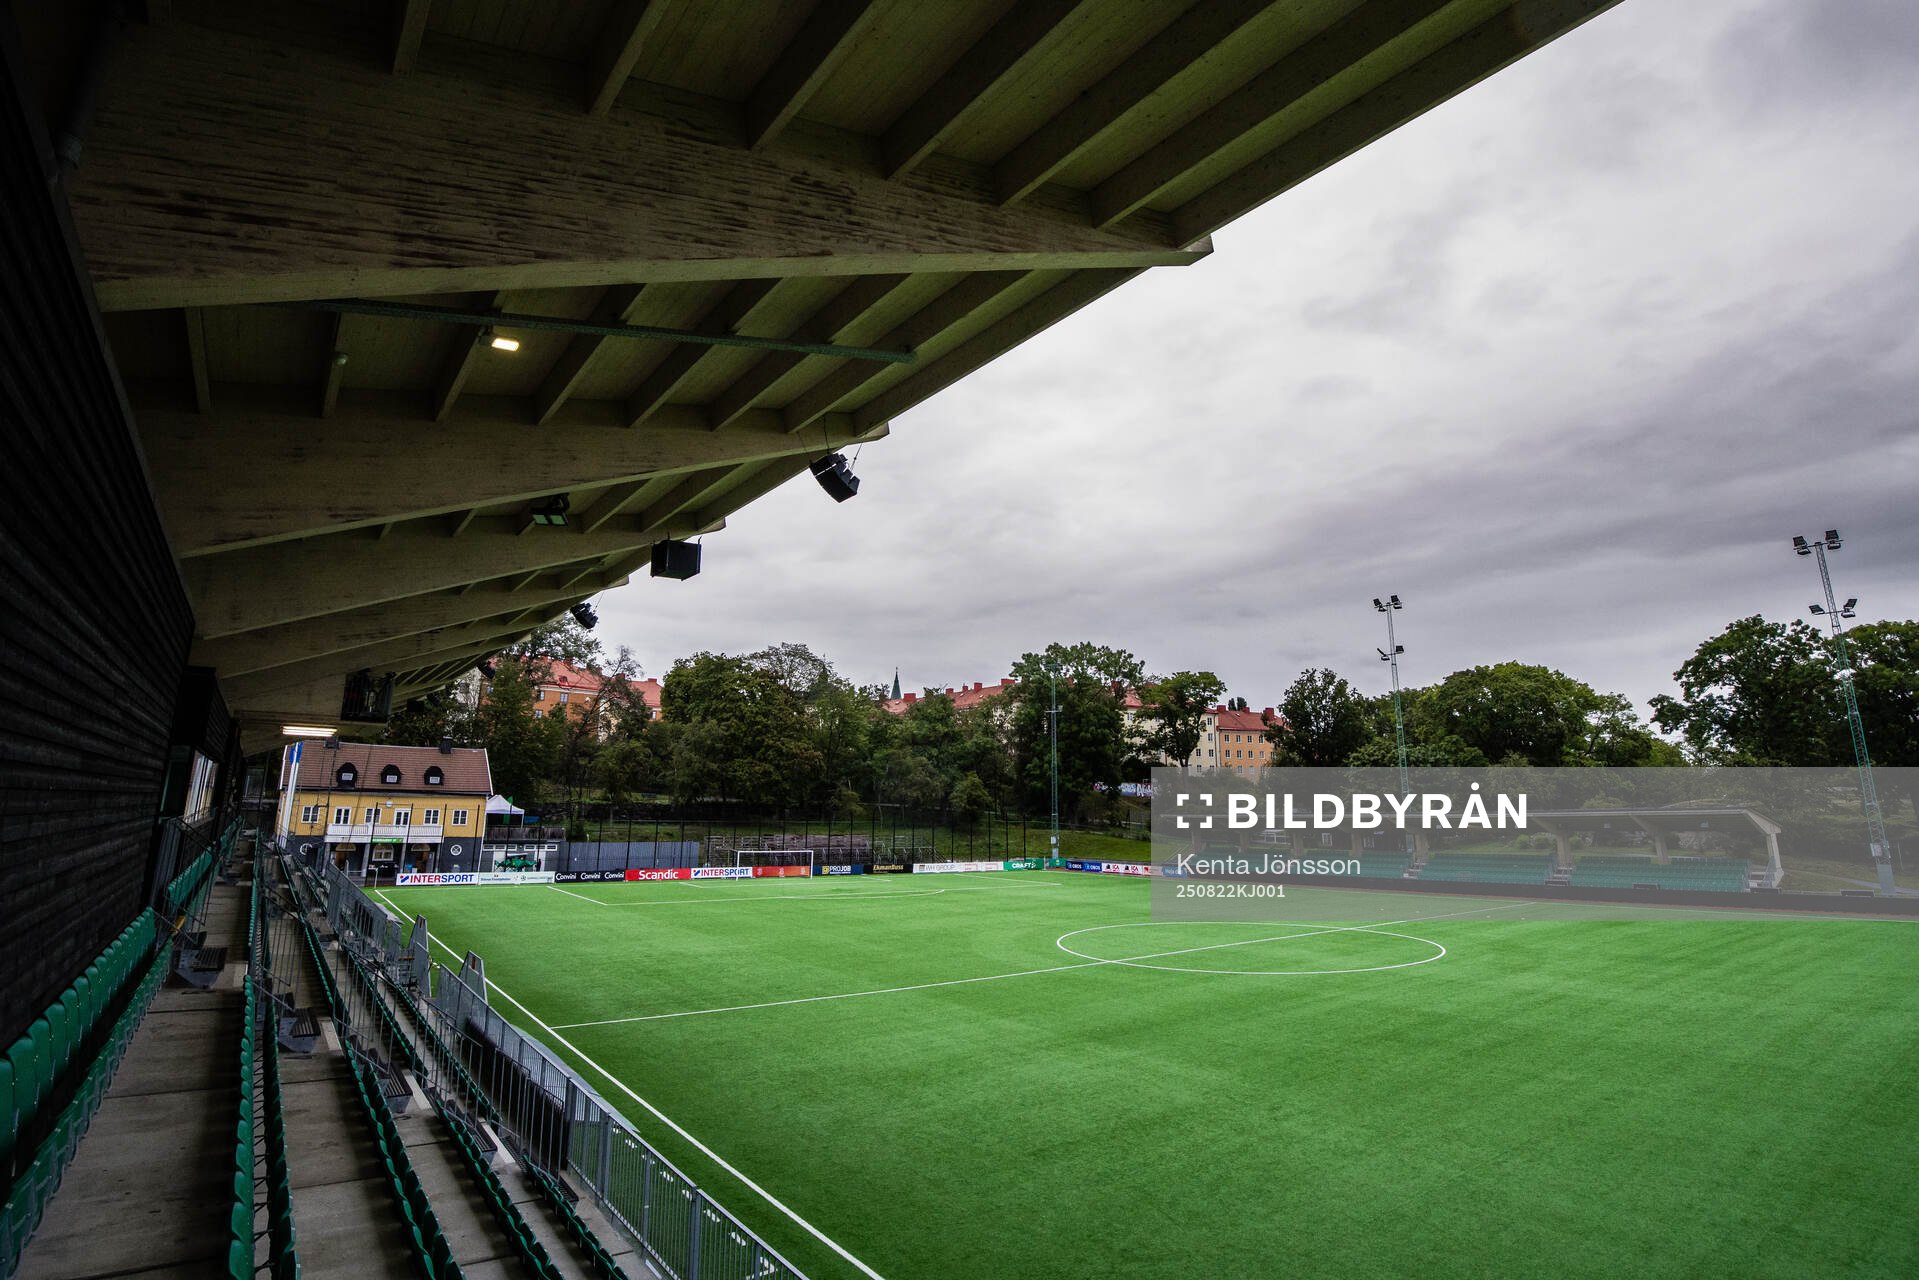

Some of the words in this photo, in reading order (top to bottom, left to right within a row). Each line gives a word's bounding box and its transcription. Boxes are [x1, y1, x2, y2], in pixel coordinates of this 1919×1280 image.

[580, 872, 601, 880] Convini
[604, 871, 625, 879] Convini
[638, 869, 679, 880] Scandic
[701, 867, 750, 877] INTERSPORT
[410, 874, 474, 883] INTERSPORT
[555, 873, 577, 881] Convini
